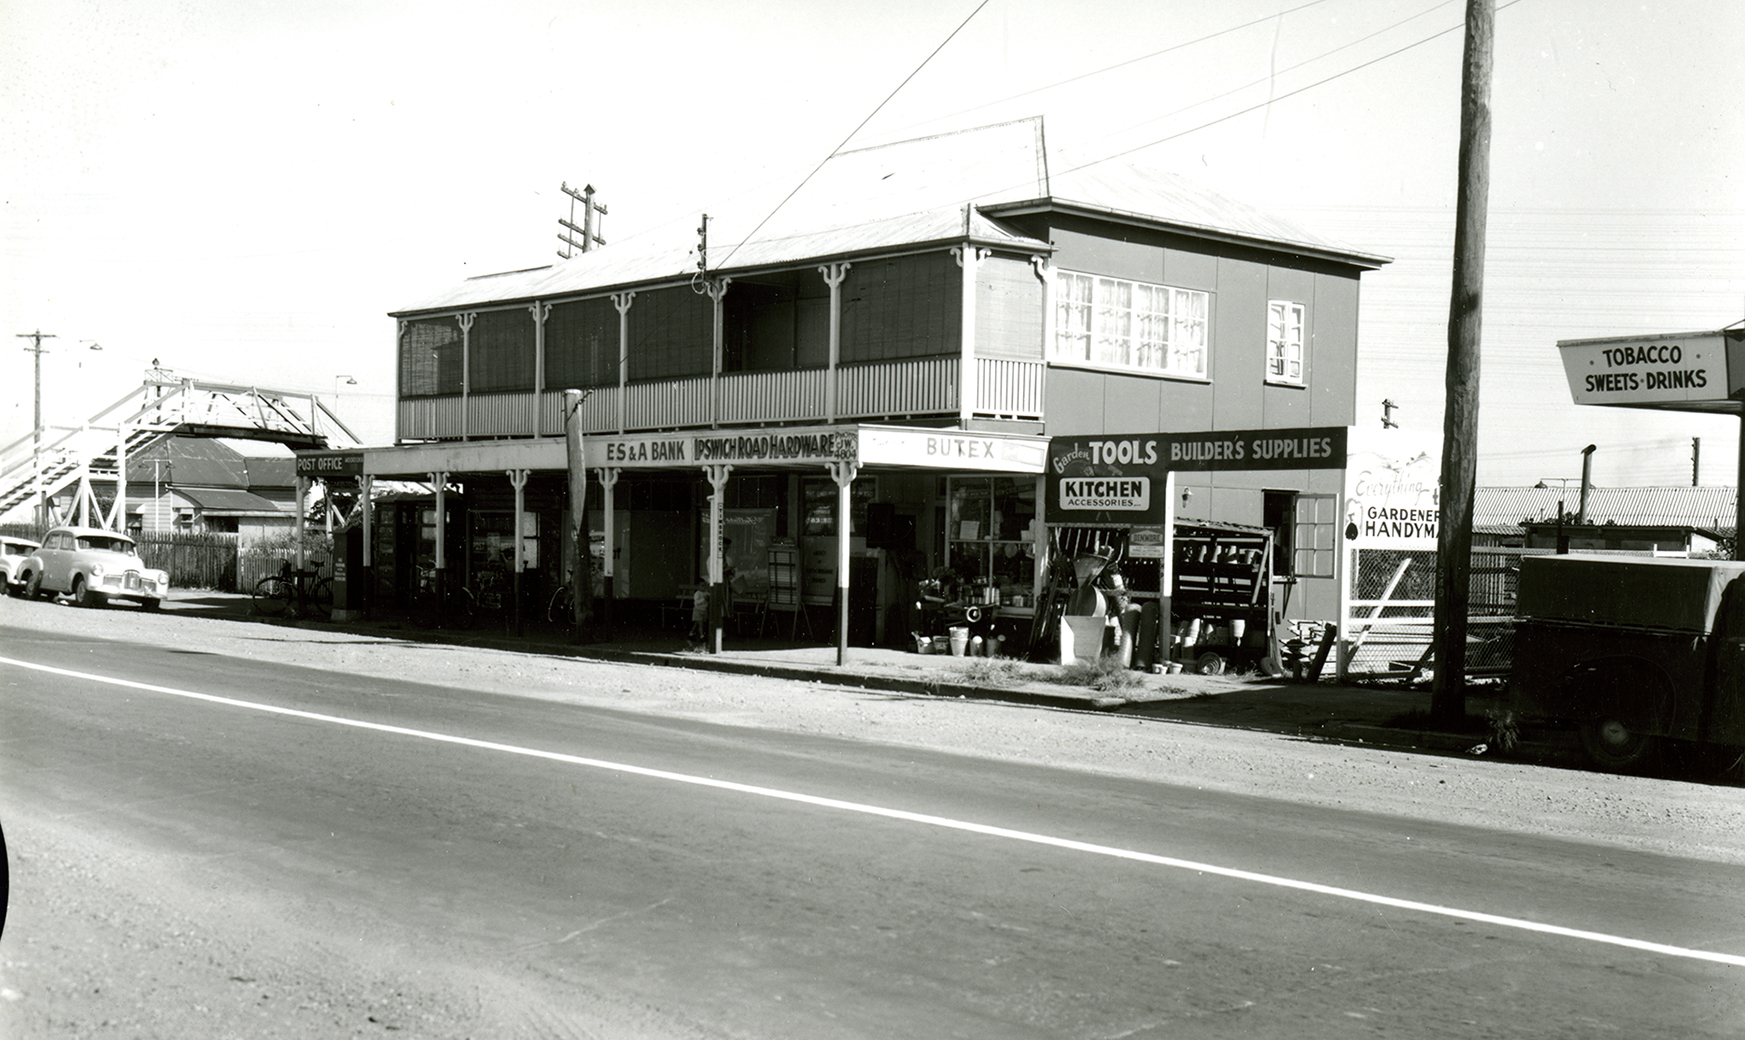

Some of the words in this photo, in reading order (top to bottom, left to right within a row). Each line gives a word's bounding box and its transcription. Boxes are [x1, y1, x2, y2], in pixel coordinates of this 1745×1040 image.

[1602, 345, 1682, 368] TOBACCO
[1585, 373, 1640, 392] SWEETS
[1646, 369, 1707, 390] DRINKS
[651, 440, 685, 461] BANK
[694, 437, 737, 461] IPSWICH
[737, 436, 769, 460] ROAD
[769, 434, 835, 459] HARDWARE
[834, 449, 857, 460] 4804
[927, 437, 995, 459] BUTEX
[1052, 442, 1091, 475] Garden
[1088, 440, 1158, 465] TOOLS
[1170, 435, 1245, 461] BUILDER'S
[1252, 437, 1332, 460] SUPPLIES
[297, 458, 316, 471] POST
[317, 457, 343, 470] OFFICE
[1065, 481, 1142, 498] KITCHEN
